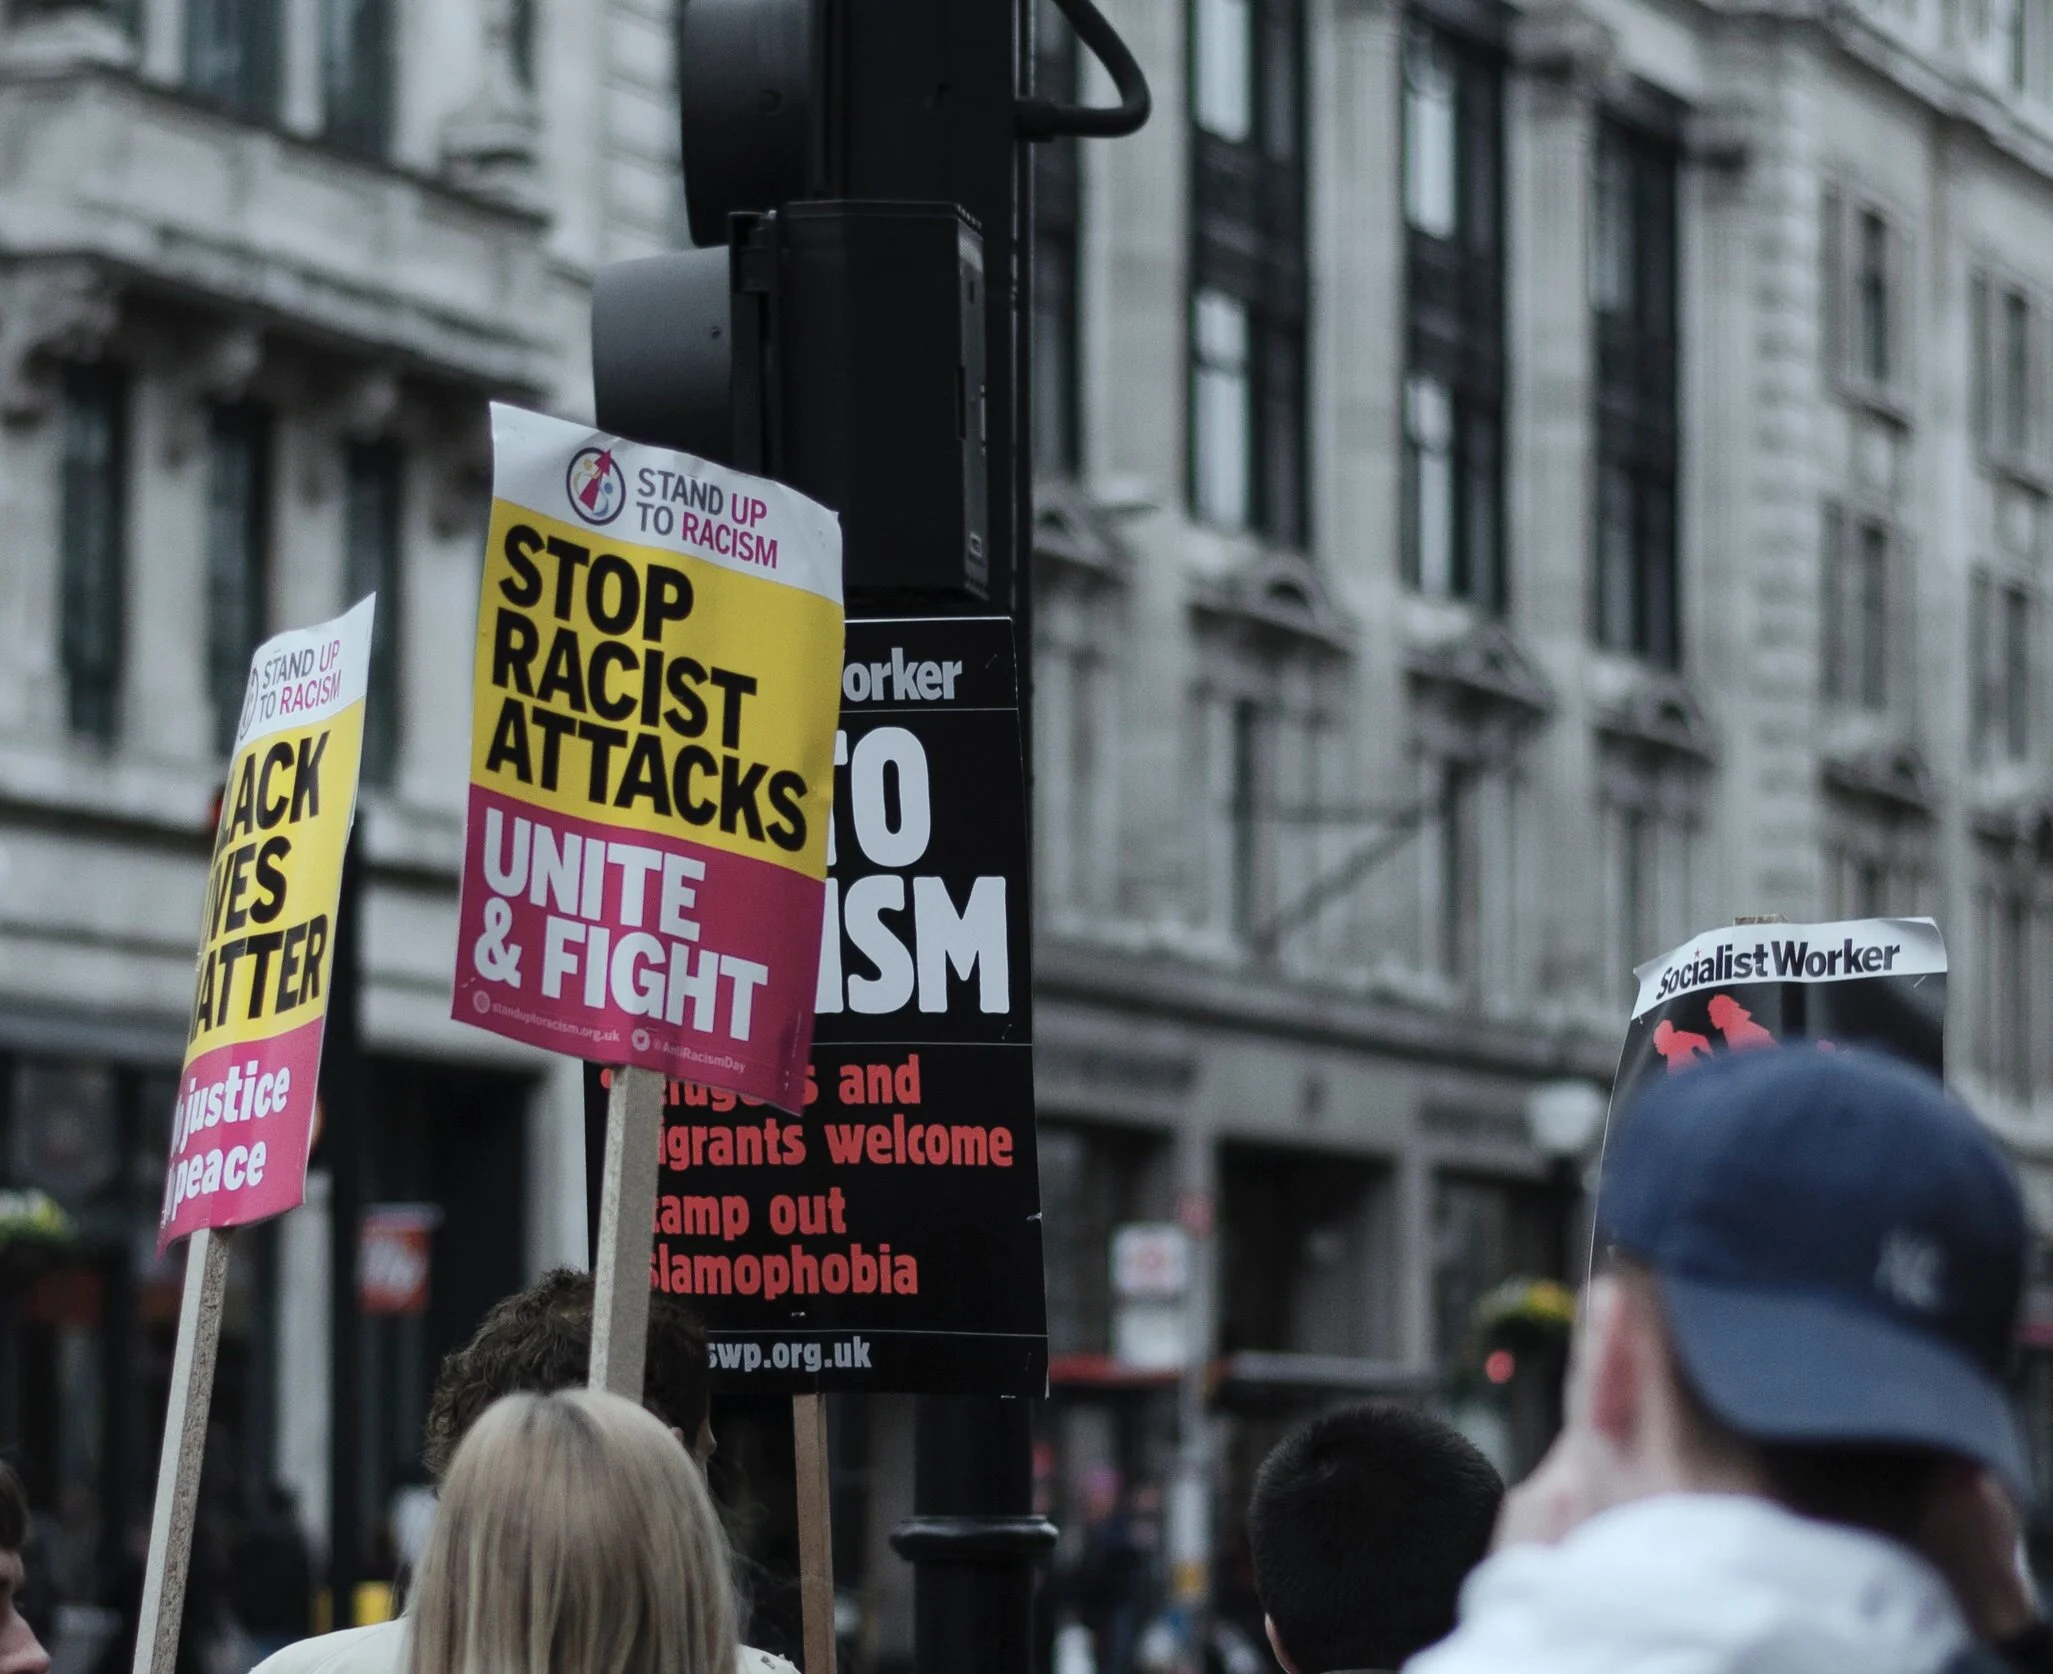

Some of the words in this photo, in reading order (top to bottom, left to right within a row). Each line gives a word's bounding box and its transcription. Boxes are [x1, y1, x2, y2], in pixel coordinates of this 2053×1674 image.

[637, 468, 723, 515] STAND
[731, 492, 767, 527] UP
[637, 501, 674, 536] TO
[682, 512, 778, 569] RACISM
[499, 524, 694, 643] STOP
[259, 690, 277, 723] TO
[279, 668, 342, 716] RACISM
[262, 648, 315, 689] STAND
[319, 640, 341, 672] UP
[492, 606, 757, 750] RACIST
[842, 647, 963, 702] orker
[485, 697, 808, 852] ATTACKS
[483, 806, 706, 942] UNITE
[473, 897, 523, 989] &
[541, 915, 768, 1042] FIGHT
[179, 1060, 290, 1155] justice
[839, 1054, 922, 1105] and
[825, 1113, 1014, 1168] welcome
[171, 1141, 267, 1222] peace
[769, 1187, 847, 1236] out
